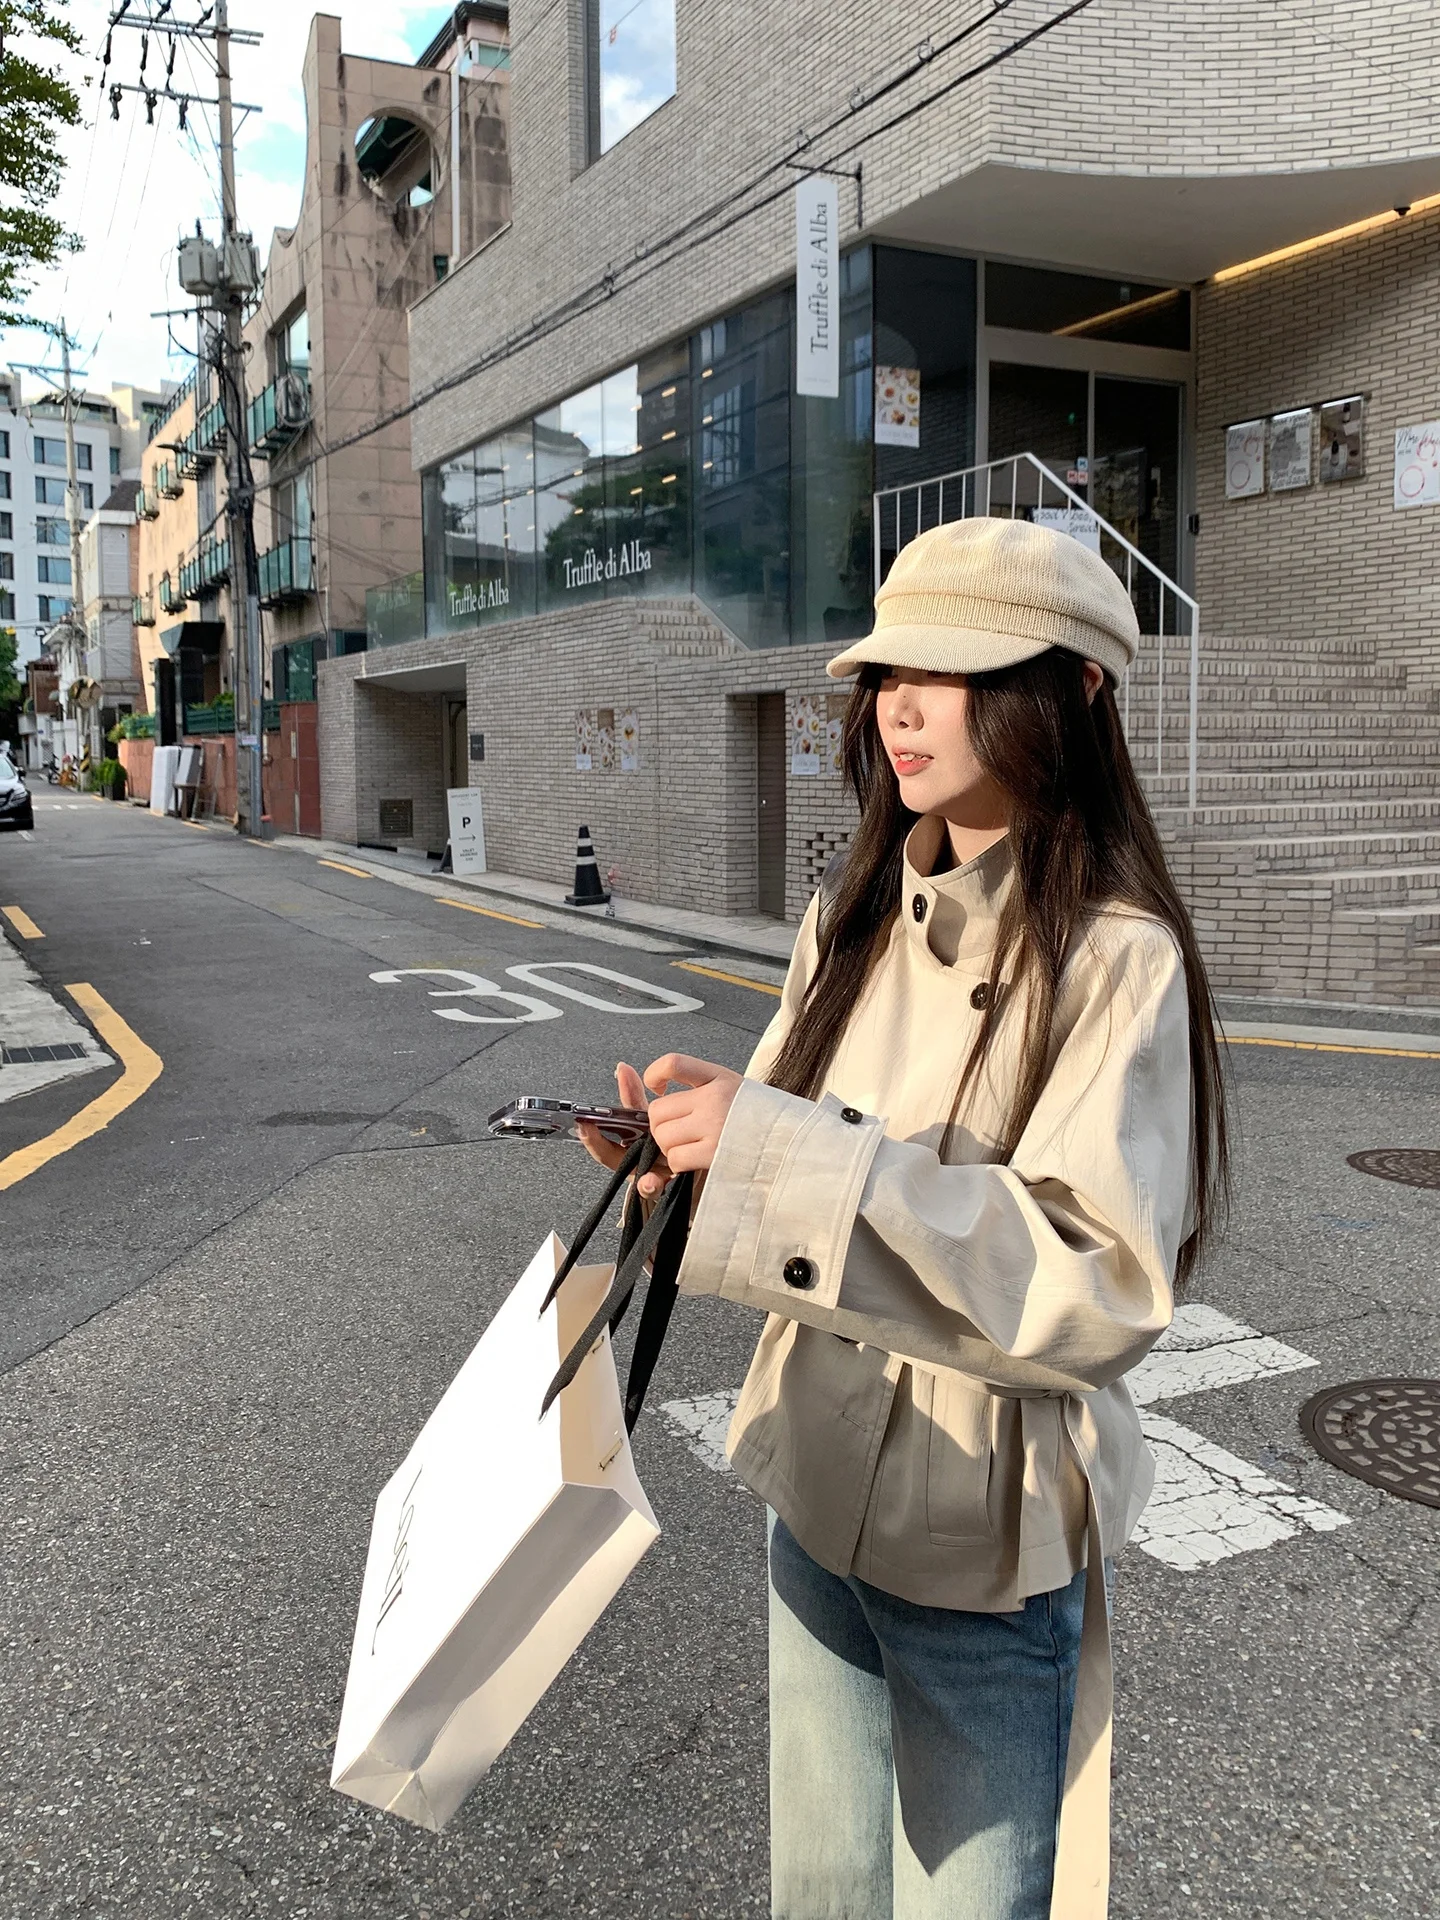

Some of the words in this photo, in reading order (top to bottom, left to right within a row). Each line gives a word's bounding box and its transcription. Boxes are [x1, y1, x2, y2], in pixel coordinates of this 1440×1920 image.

[809, 202, 828, 254] Alba
[810, 257, 829, 279] di
[808, 281, 829, 354] Truffle
[563, 547, 604, 589] Truffle
[604, 547, 617, 580] di
[619, 539, 652, 576] Alba
[450, 583, 478, 617] Truffle
[477, 584, 487, 609] di
[487, 578, 510, 608] Alba
[462, 816, 471, 829] P
[368, 961, 706, 1024] 30
